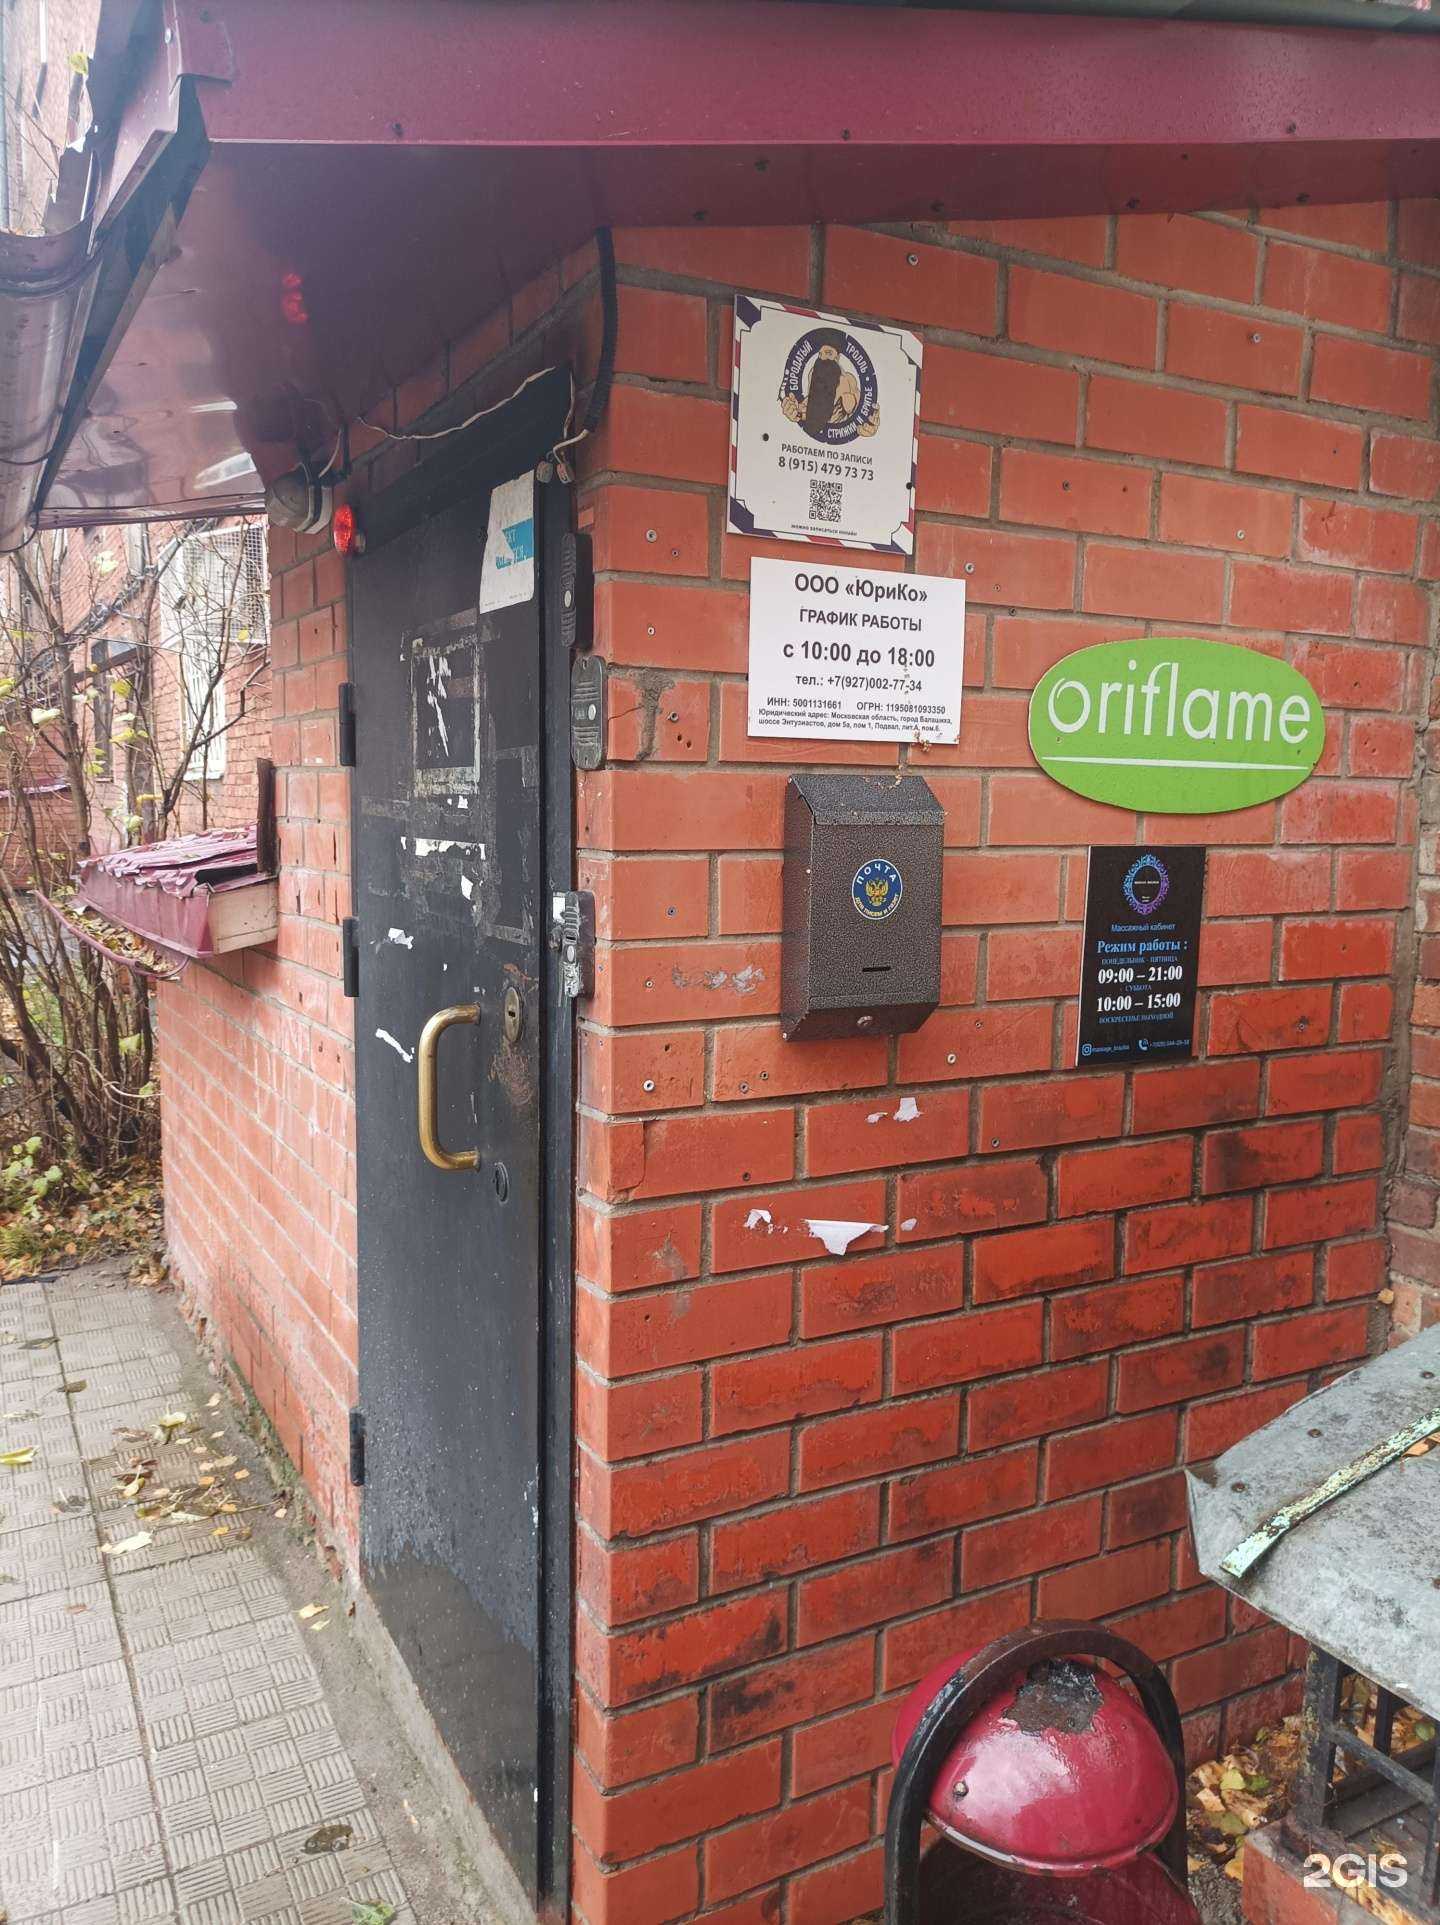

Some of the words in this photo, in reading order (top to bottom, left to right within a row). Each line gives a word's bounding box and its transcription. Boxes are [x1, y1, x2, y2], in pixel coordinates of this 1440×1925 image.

[789, 340, 814, 391] БОРОДАТЫЙ
[846, 341, 867, 374] ТРОЛЛЬ
[827, 420, 858, 439] СТРИЖКИ
[860, 386, 874, 415] БРИТЬЕ
[781, 443, 825, 458] РАБОТАЕМ
[827, 451, 839, 460] ПО
[840, 453, 873, 465] ЗАПИСИ
[778, 456, 786, 467] 8
[789, 457, 818, 474] (915)
[821, 460, 842, 476] 479
[844, 466, 858, 479] 73
[861, 469, 874, 481] 73
[794, 573, 839, 594] ООО
[845, 579, 928, 602] «ЮриКо»
[800, 608, 858, 627] ГРАФИК
[862, 614, 922, 631] РАБОТЫ
[783, 643, 794, 658] с
[801, 640, 851, 661] 10:00
[856, 649, 881, 665] до
[888, 646, 935, 667] 18:00
[796, 675, 823, 686] тел.:
[827, 675, 922, 691] +7(927)002-77-34
[767, 697, 790, 707] ИНН:
[792, 698, 841, 709] 5001131661
[856, 701, 884, 711] ОГРН:
[886, 703, 946, 714] 1195081093350
[1048, 659, 1311, 744] oriflame
[758, 708, 807, 717] Юридический
[807, 711, 830, 719] адрес:
[830, 712, 869, 720] Московская
[871, 713, 899, 721] область,
[900, 715, 919, 723] город
[781, 718, 826, 728] Энтузиастов,
[856, 863, 897, 885] ПОЧТА
[1111, 923, 1150, 932] Массажный
[1150, 922, 1176, 931] кабинет
[1097, 940, 1136, 954] Режим
[1139, 938, 1180, 955] работы
[1098, 968, 1134, 984] 09:00
[1148, 965, 1183, 981] 21:00
[1097, 995, 1132, 1012] 10:00
[1147, 993, 1181, 1009] 15:00
